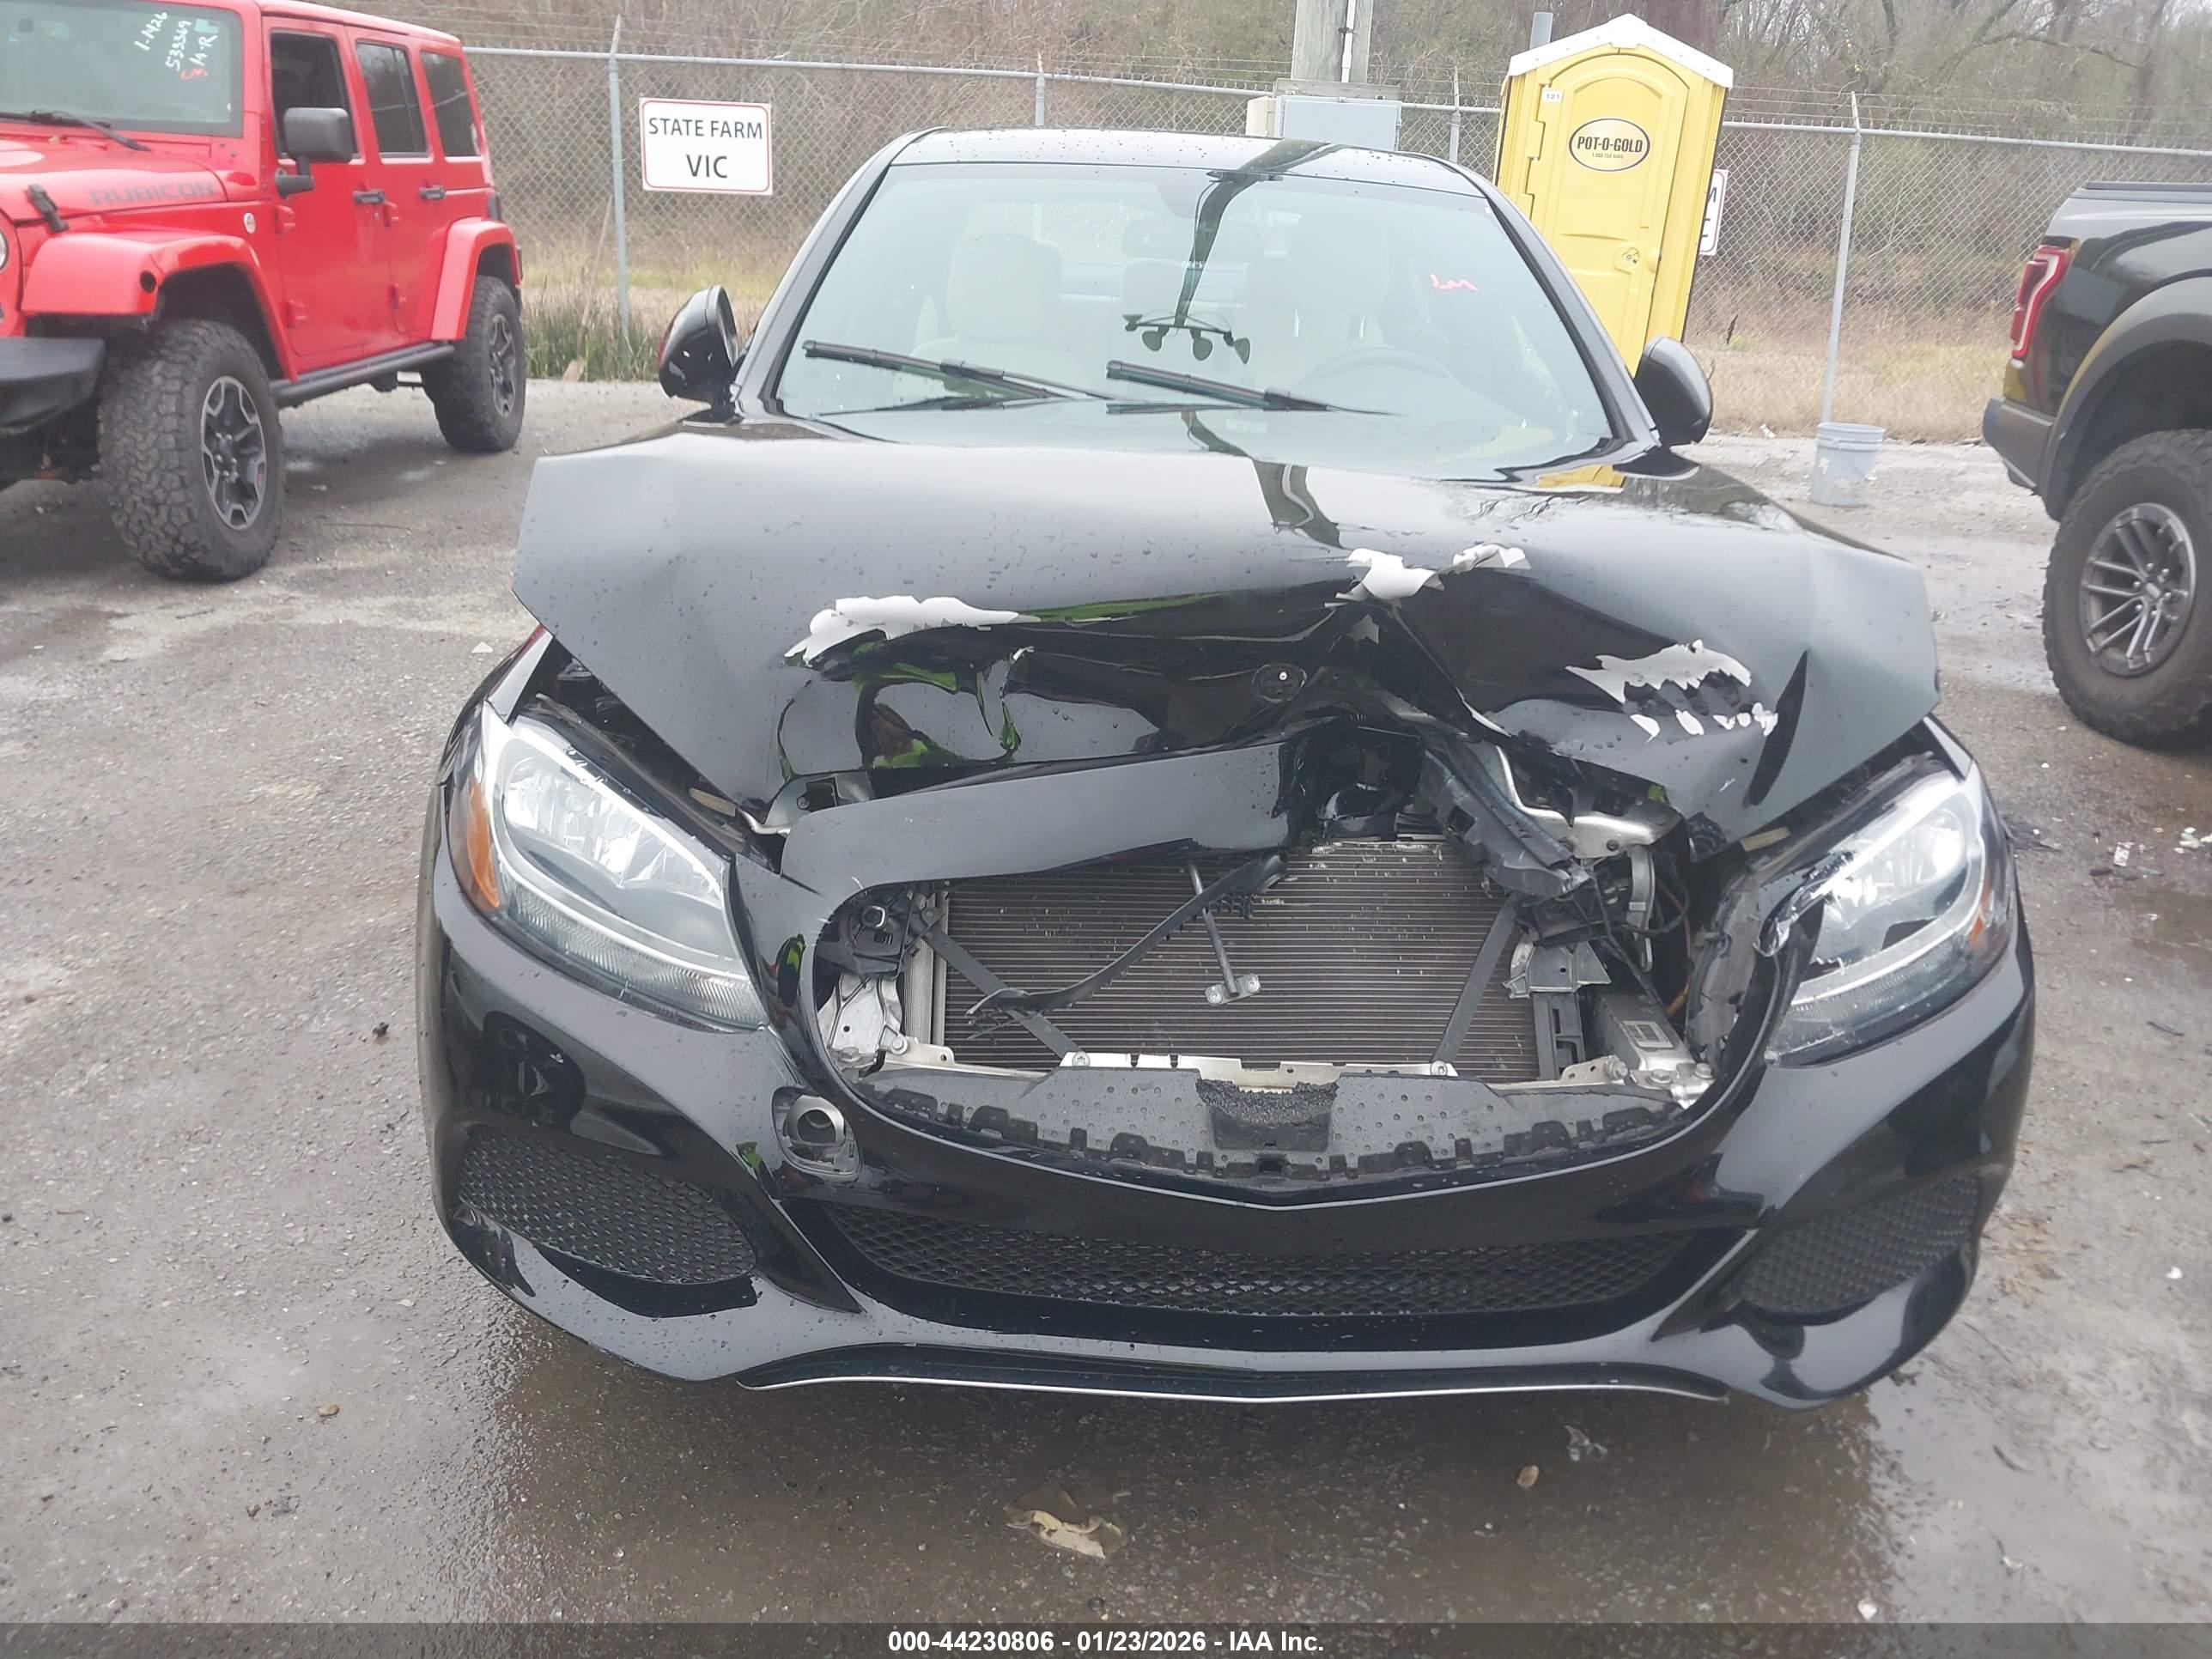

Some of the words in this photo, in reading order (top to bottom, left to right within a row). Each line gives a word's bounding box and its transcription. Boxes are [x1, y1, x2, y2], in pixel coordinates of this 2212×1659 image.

[648, 118, 705, 137] STATE
[710, 120, 763, 139] FARM
[1577, 136, 1644, 153] POT-O-GOLD
[685, 154, 728, 179] VIC
[89, 181, 216, 207] RUBICON
